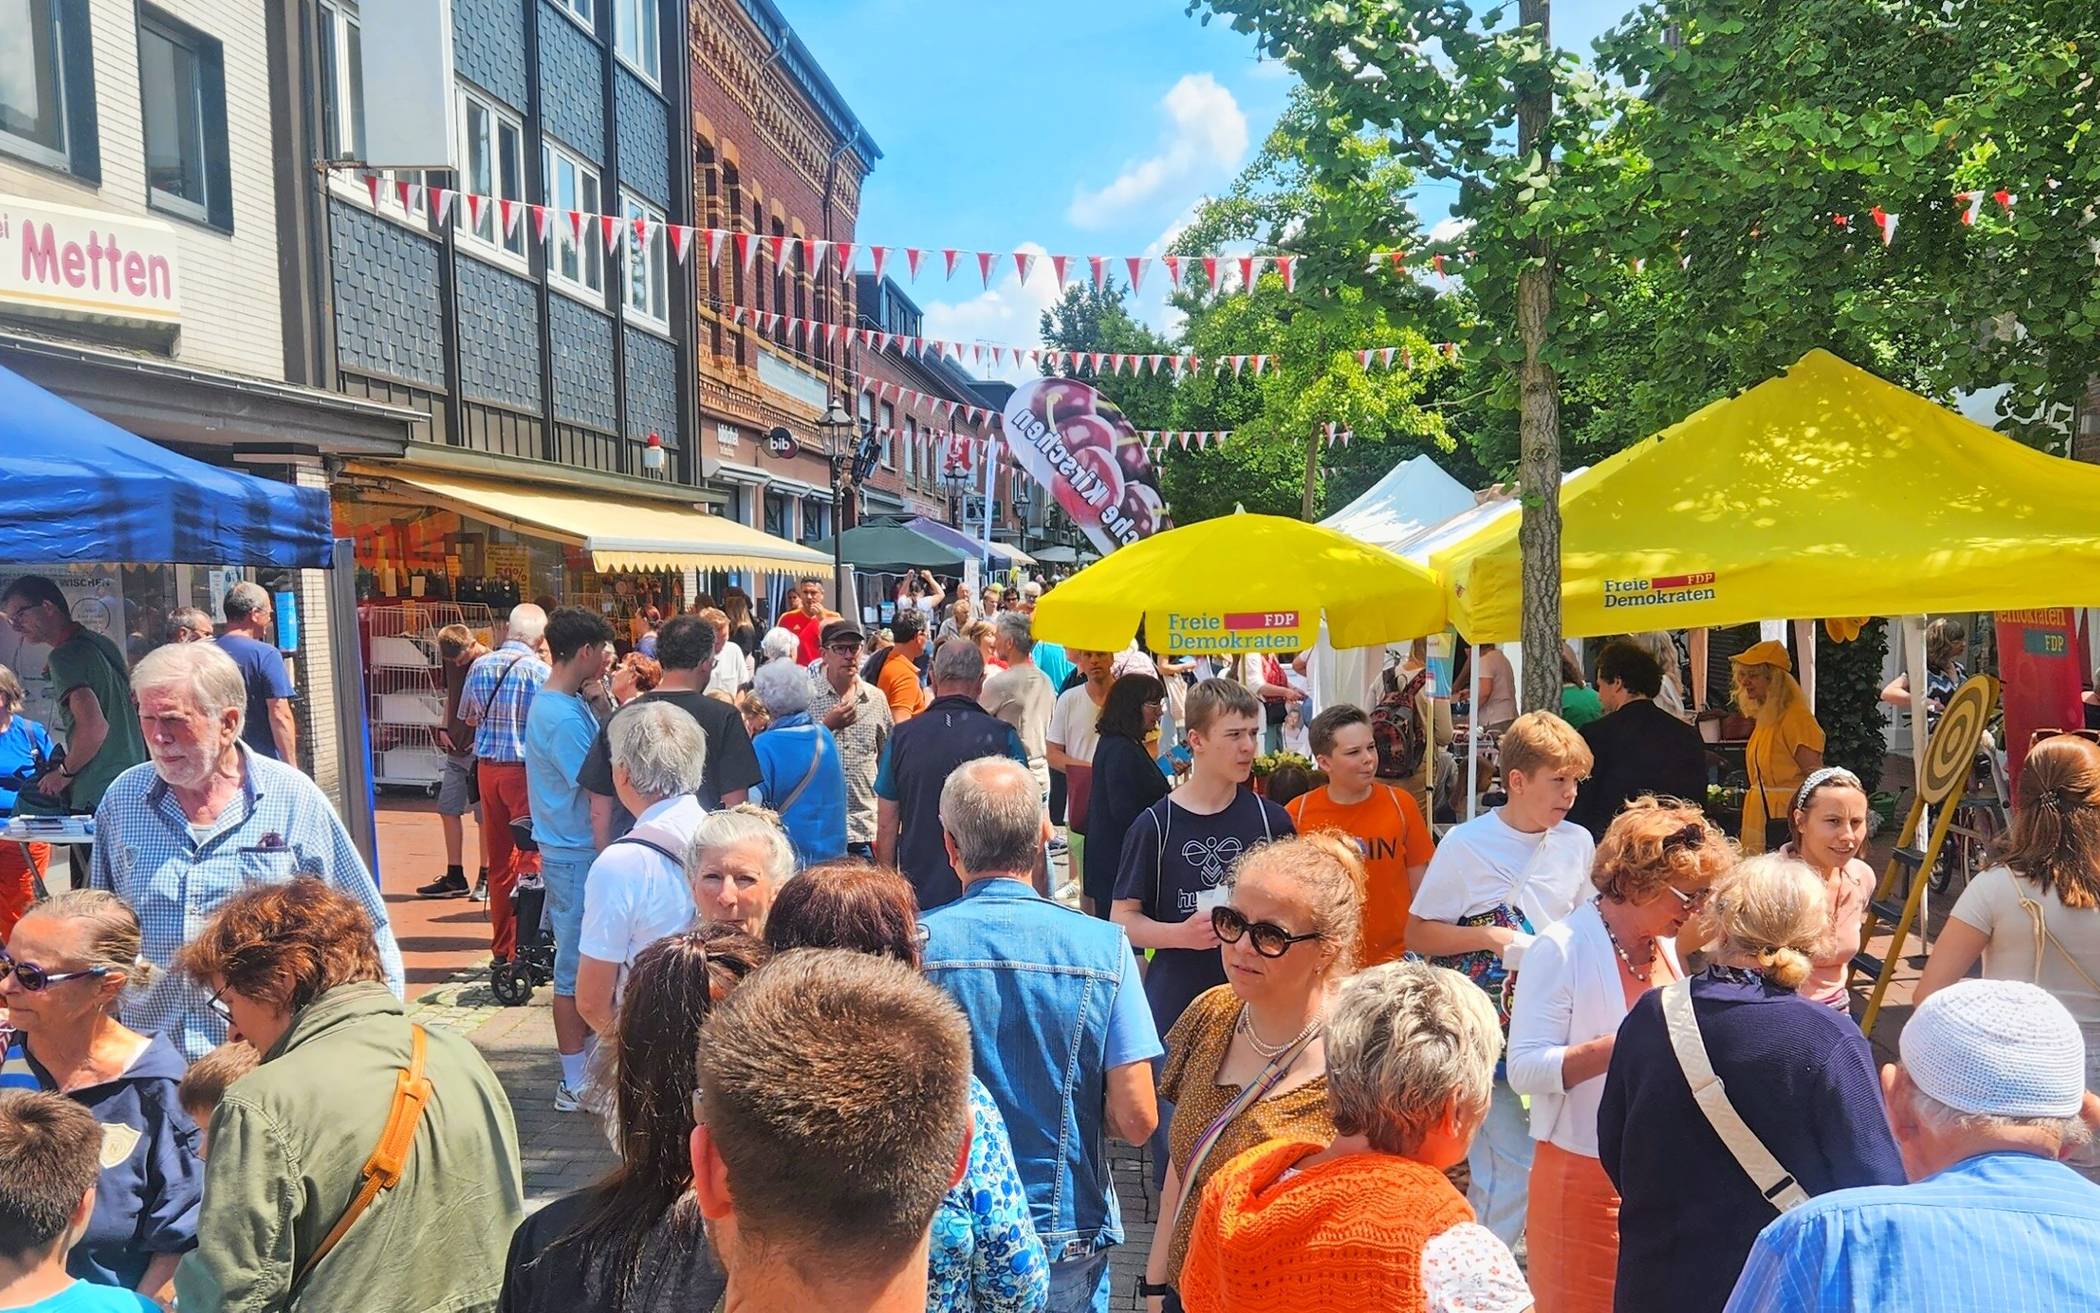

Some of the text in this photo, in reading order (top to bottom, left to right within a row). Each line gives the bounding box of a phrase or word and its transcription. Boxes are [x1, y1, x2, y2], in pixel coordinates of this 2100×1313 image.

[22, 218, 171, 300] Metten
[770, 437, 790, 450] bib
[1604, 573, 1713, 592] Freie FDP
[1604, 588, 1716, 608] Demokraten
[1168, 613, 1295, 630] Freie FDP
[1168, 631, 1299, 650] Demokraten
[2044, 634, 2065, 652] FDP
[1356, 837, 1398, 861] IN
